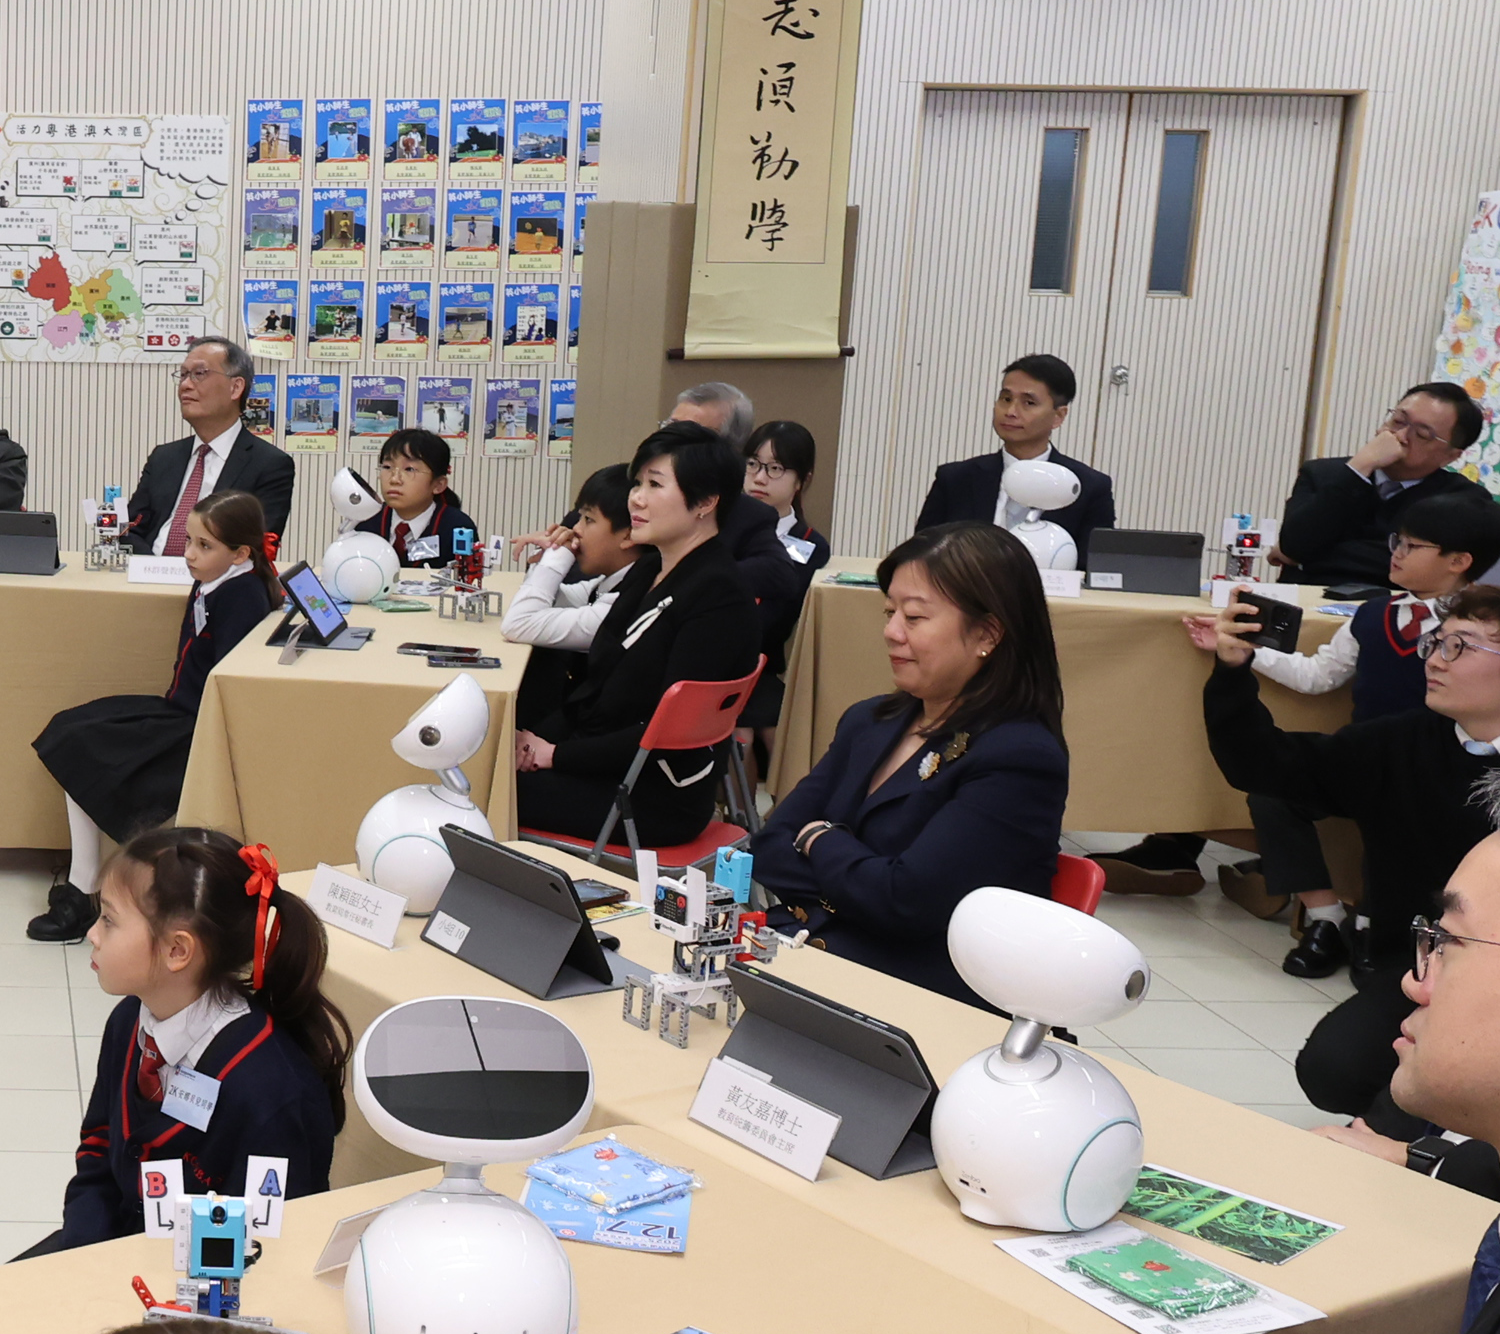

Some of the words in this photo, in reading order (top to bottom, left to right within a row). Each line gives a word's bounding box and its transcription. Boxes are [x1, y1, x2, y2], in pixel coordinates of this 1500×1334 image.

[16, 124, 142, 138] 活力粵港澳大灣區
[438, 919, 456, 936] 小組
[454, 928, 466, 940] 10
[169, 1084, 179, 1097] 2K
[724, 1084, 803, 1137] 黃友嘉博士
[717, 1107, 796, 1155] 教育統籌委員會主席
[145, 1171, 167, 1198] B
[259, 1168, 282, 1197] A
